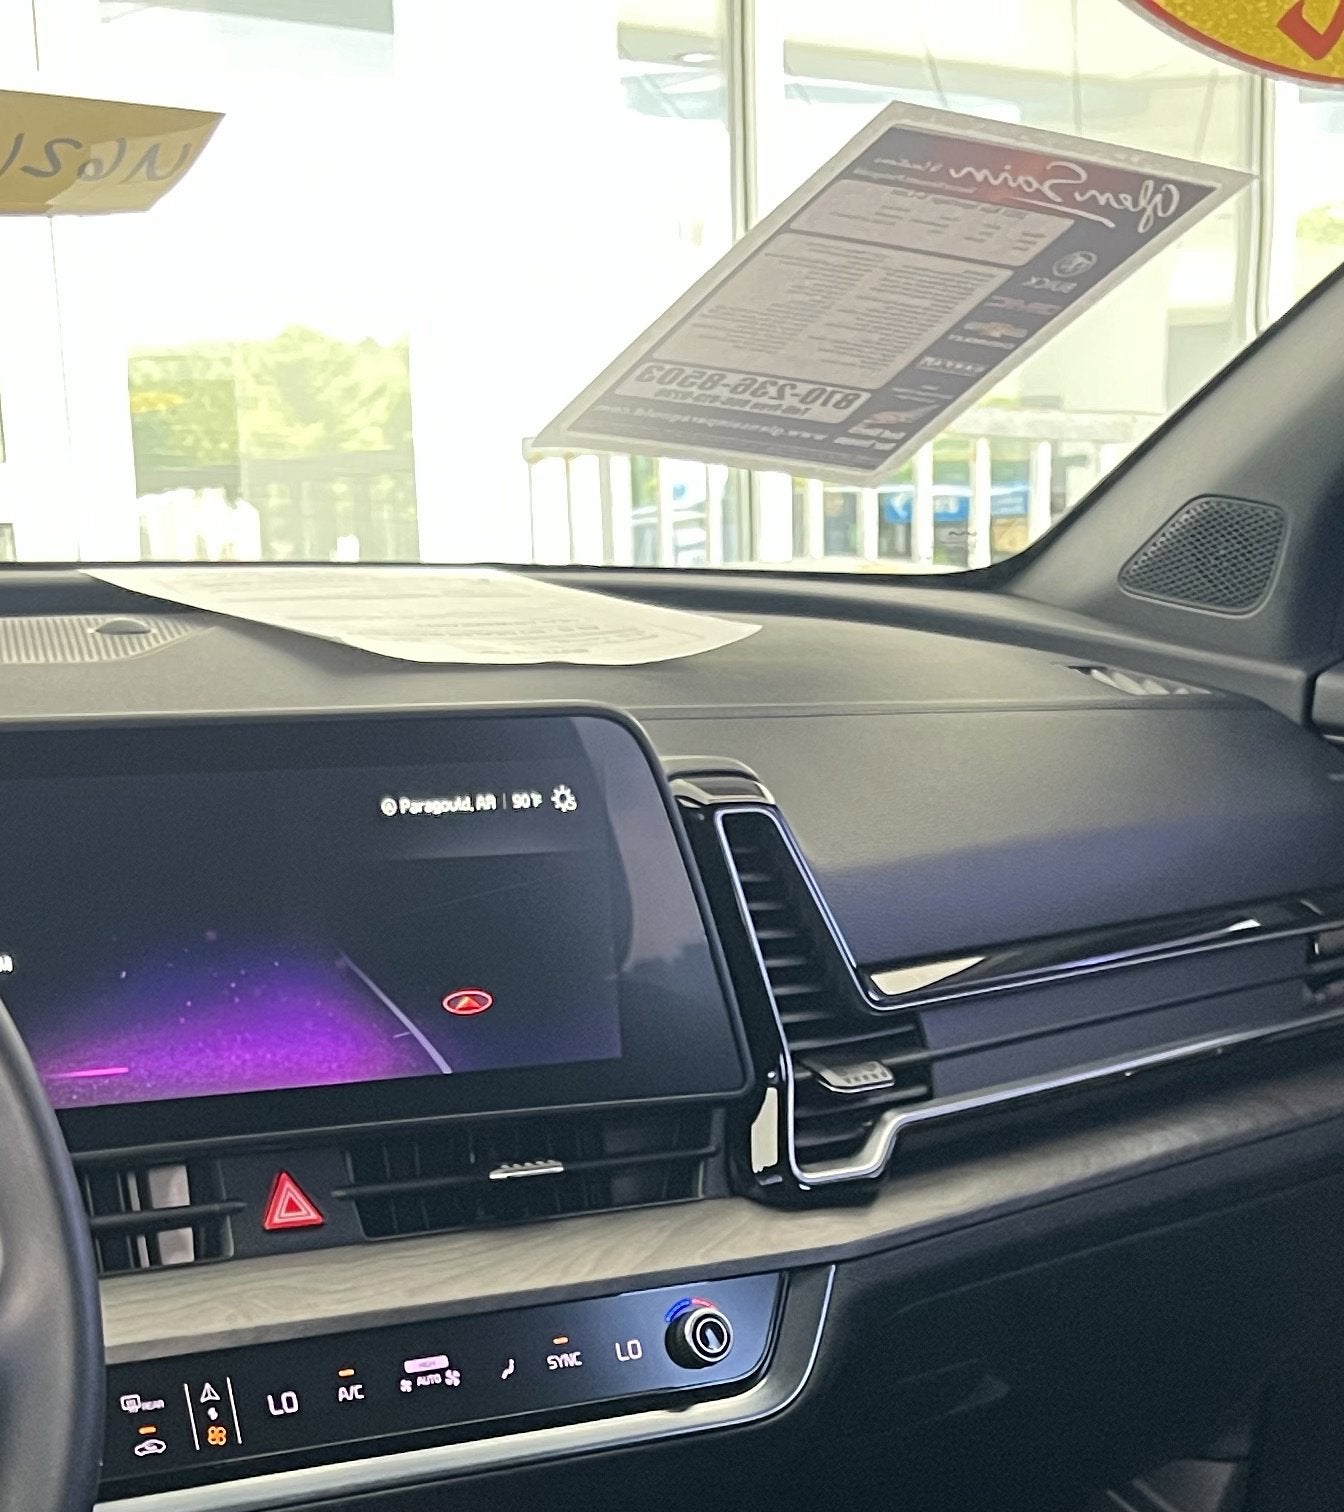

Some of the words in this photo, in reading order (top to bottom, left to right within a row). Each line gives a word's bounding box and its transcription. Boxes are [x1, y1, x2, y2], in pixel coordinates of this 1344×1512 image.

[615, 1339, 643, 1362] LO
[547, 1351, 583, 1371] SYNC
[416, 1373, 442, 1387] AUTO
[267, 1391, 298, 1415] LO
[338, 1384, 364, 1402] A/C
